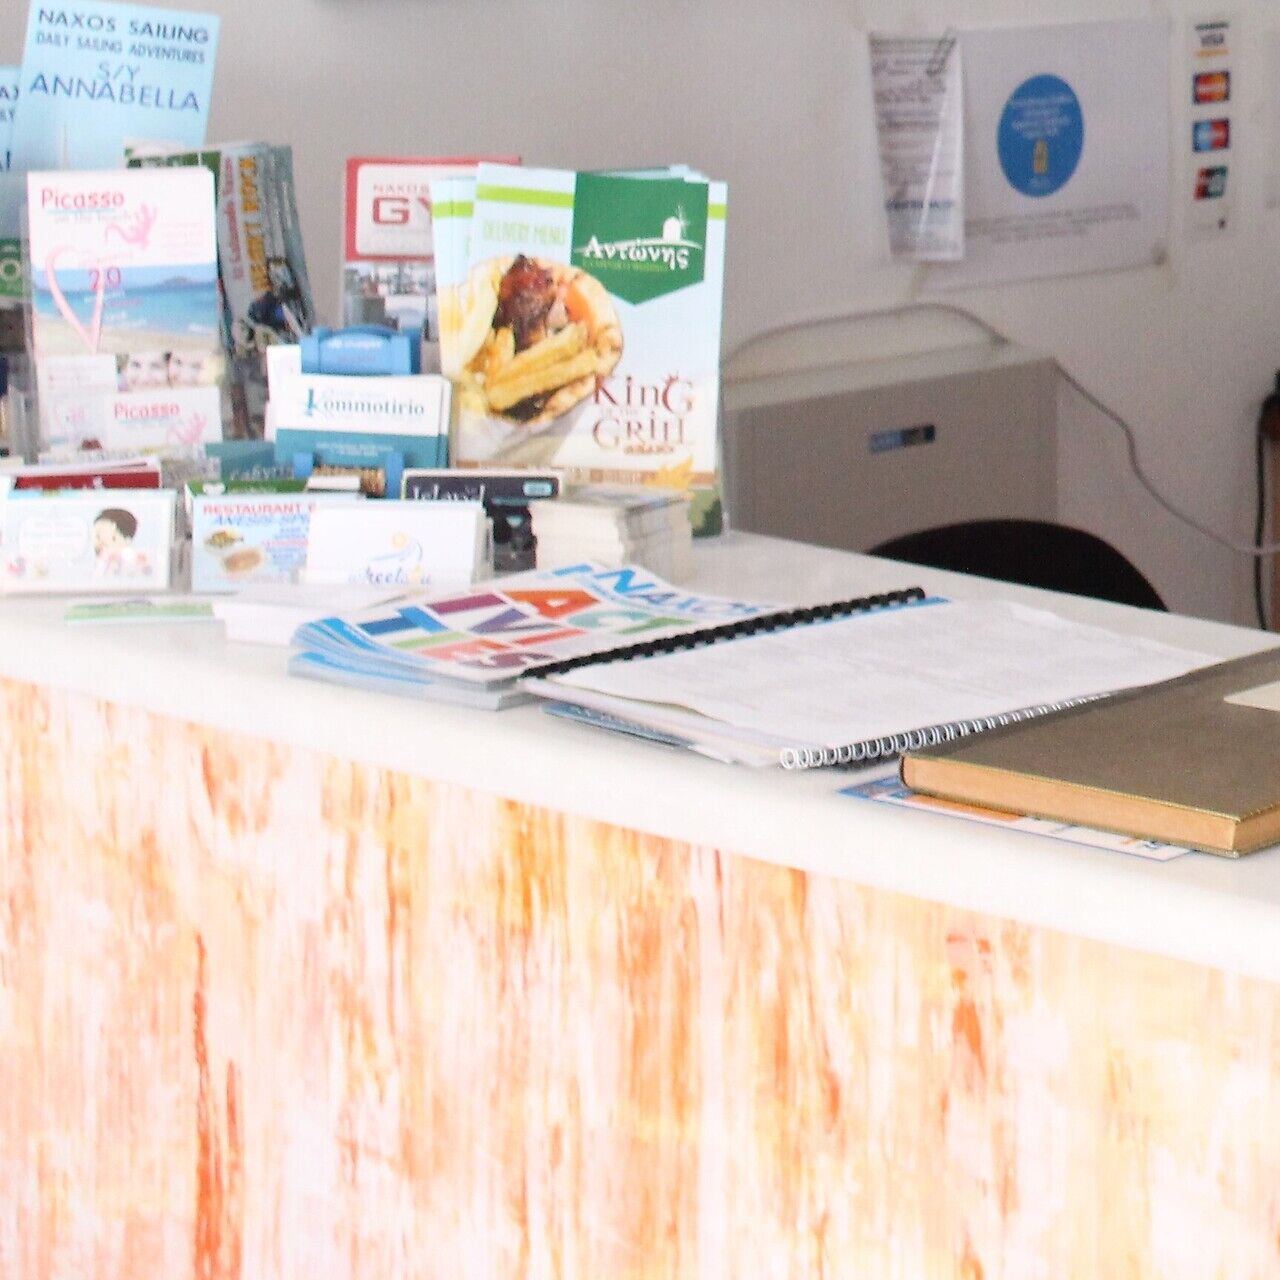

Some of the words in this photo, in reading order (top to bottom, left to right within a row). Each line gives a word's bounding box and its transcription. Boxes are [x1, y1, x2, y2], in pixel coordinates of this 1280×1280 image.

[38, 8, 117, 33] NAXOS
[128, 20, 210, 45] SAILING
[29, 71, 200, 113] ANNABELLA
[41, 185, 125, 209] Picasso
[113, 402, 181, 419] Picasso
